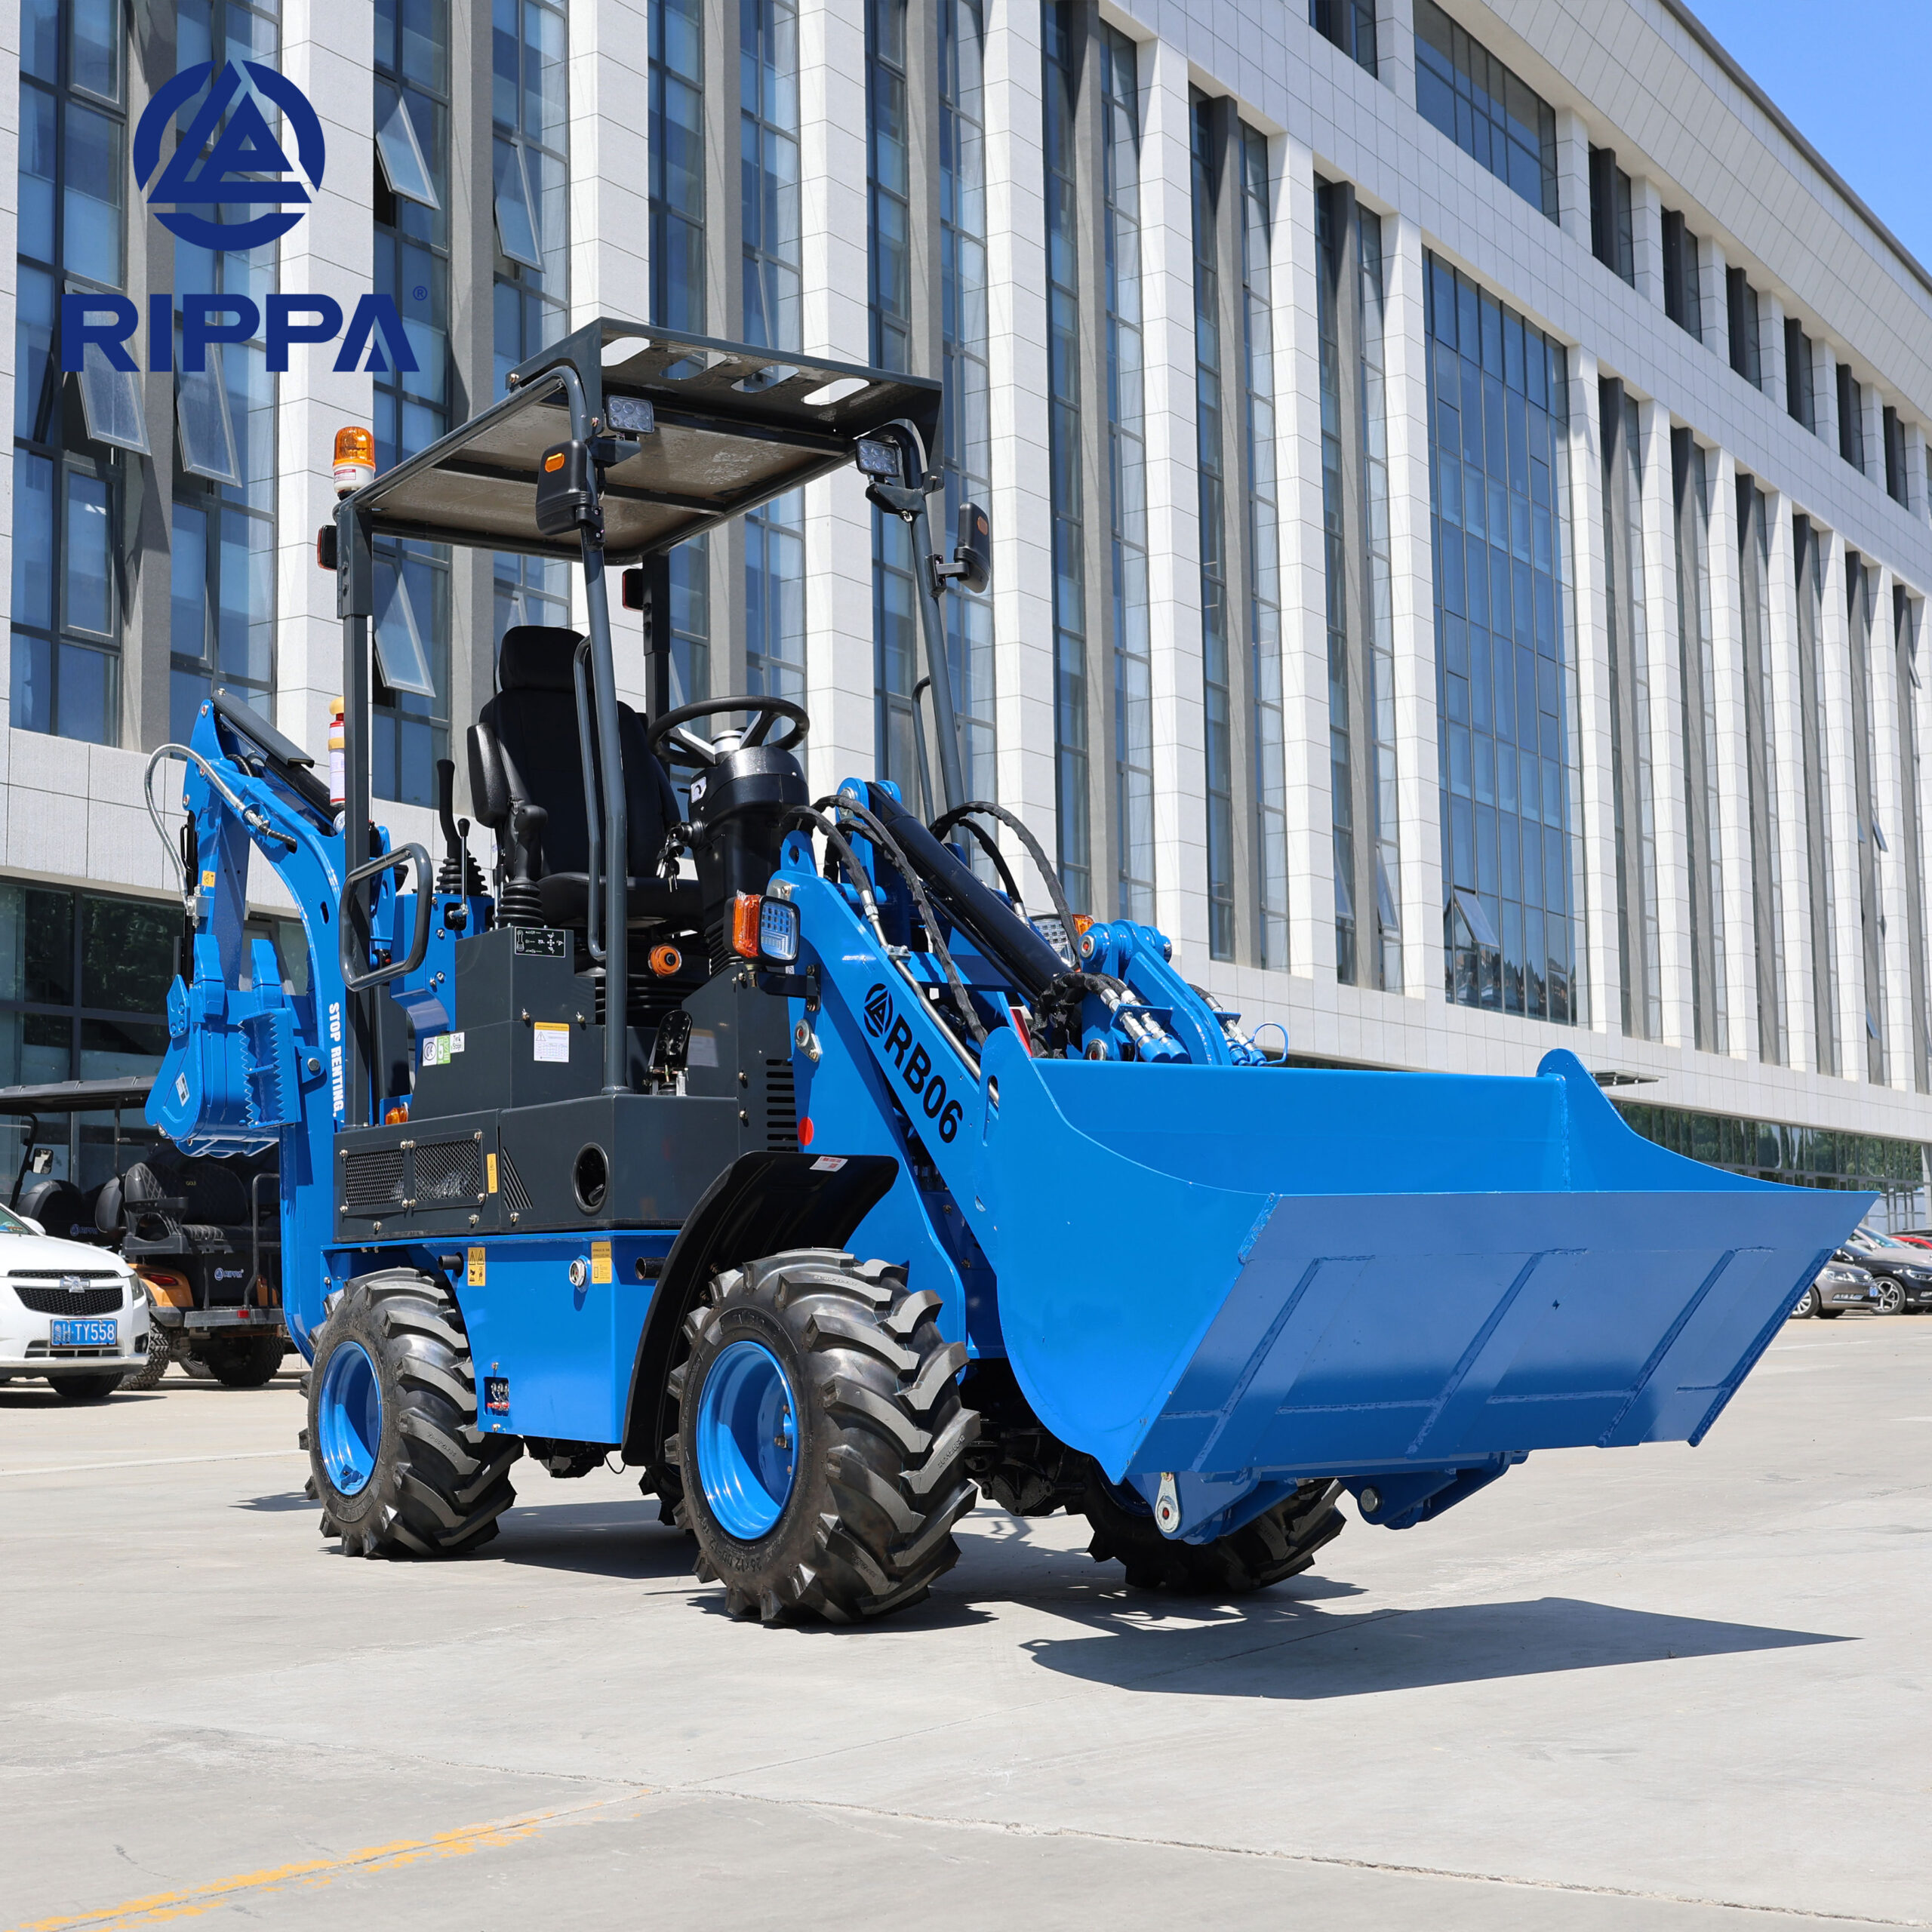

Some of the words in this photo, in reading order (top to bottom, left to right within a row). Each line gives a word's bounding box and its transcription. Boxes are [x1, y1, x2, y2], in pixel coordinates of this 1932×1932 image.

[329, 1002, 341, 1041] STOP
[331, 1045, 344, 1118] RENTING.
[884, 1014, 963, 1143] RB06
